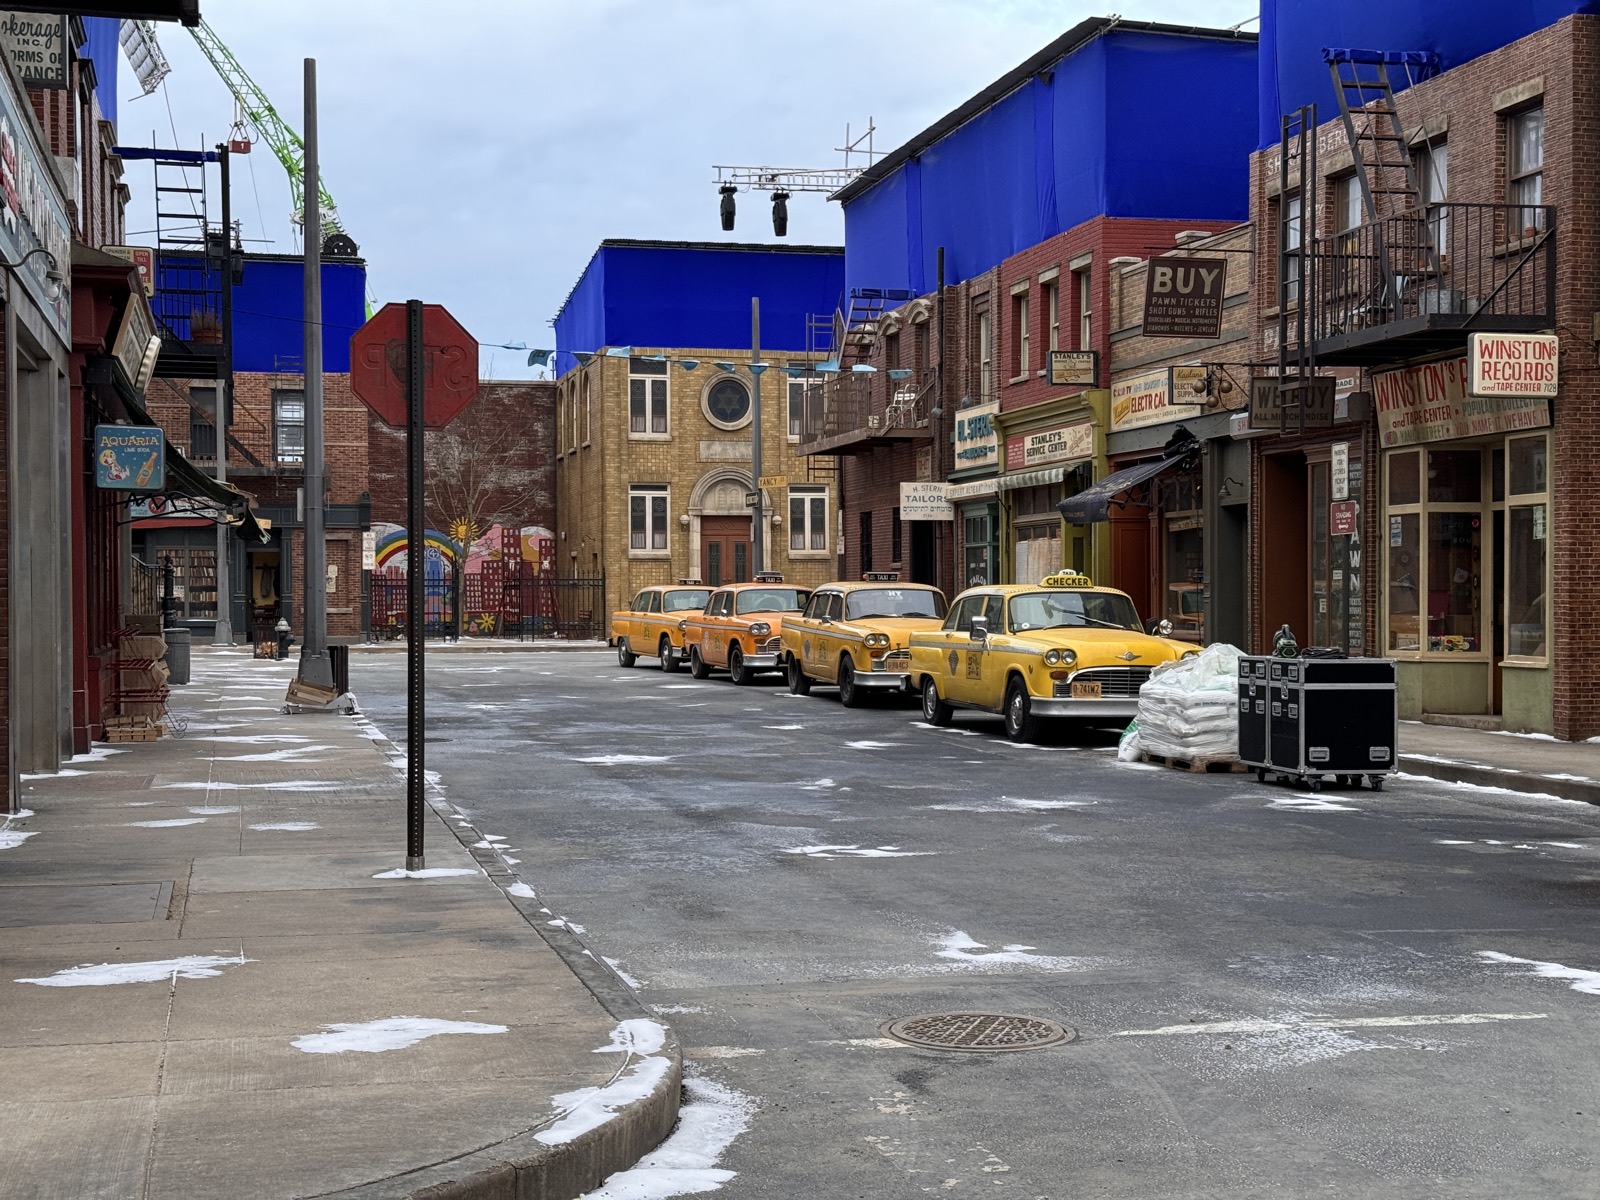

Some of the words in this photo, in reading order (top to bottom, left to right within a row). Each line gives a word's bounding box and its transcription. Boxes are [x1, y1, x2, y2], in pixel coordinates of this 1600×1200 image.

[17, 38, 43, 47] INC.
[1153, 266, 1220, 295] BUY
[1152, 297, 1177, 306] PAWN
[1180, 298, 1217, 307] TICKETS
[1149, 306, 1167, 315] SHOT
[1168, 307, 1187, 316] GUNS
[1195, 308, 1218, 316] RIFLES
[1481, 361, 1554, 381] RECORDS
[1481, 383, 1496, 391] and
[1496, 382, 1514, 391] TAPE
[1515, 383, 1542, 392] CENTER
[1543, 383, 1557, 393] 7128
[1258, 387, 1281, 409] WE
[1291, 386, 1329, 409] BUY
[1462, 400, 1494, 417] POPULAR
[1254, 412, 1269, 421] ALL
[1392, 413, 1406, 428] and
[1405, 411, 1423, 426] TAPE
[1423, 405, 1452, 423] CENTER
[1422, 424, 1445, 441] STREET
[1455, 421, 1469, 436] YOU
[1471, 417, 1492, 435] NAME
[1504, 413, 1517, 430] WE
[1517, 410, 1537, 427] HAVE
[100, 436, 160, 447] AQUARIA
[1031, 431, 1062, 447] STANLEY'S
[1026, 445, 1046, 458] SERVICE
[1047, 441, 1068, 454] CENTER
[921, 485, 943, 493] STERN
[905, 495, 950, 503] TAILORS
[1046, 577, 1089, 586] CHECKER
